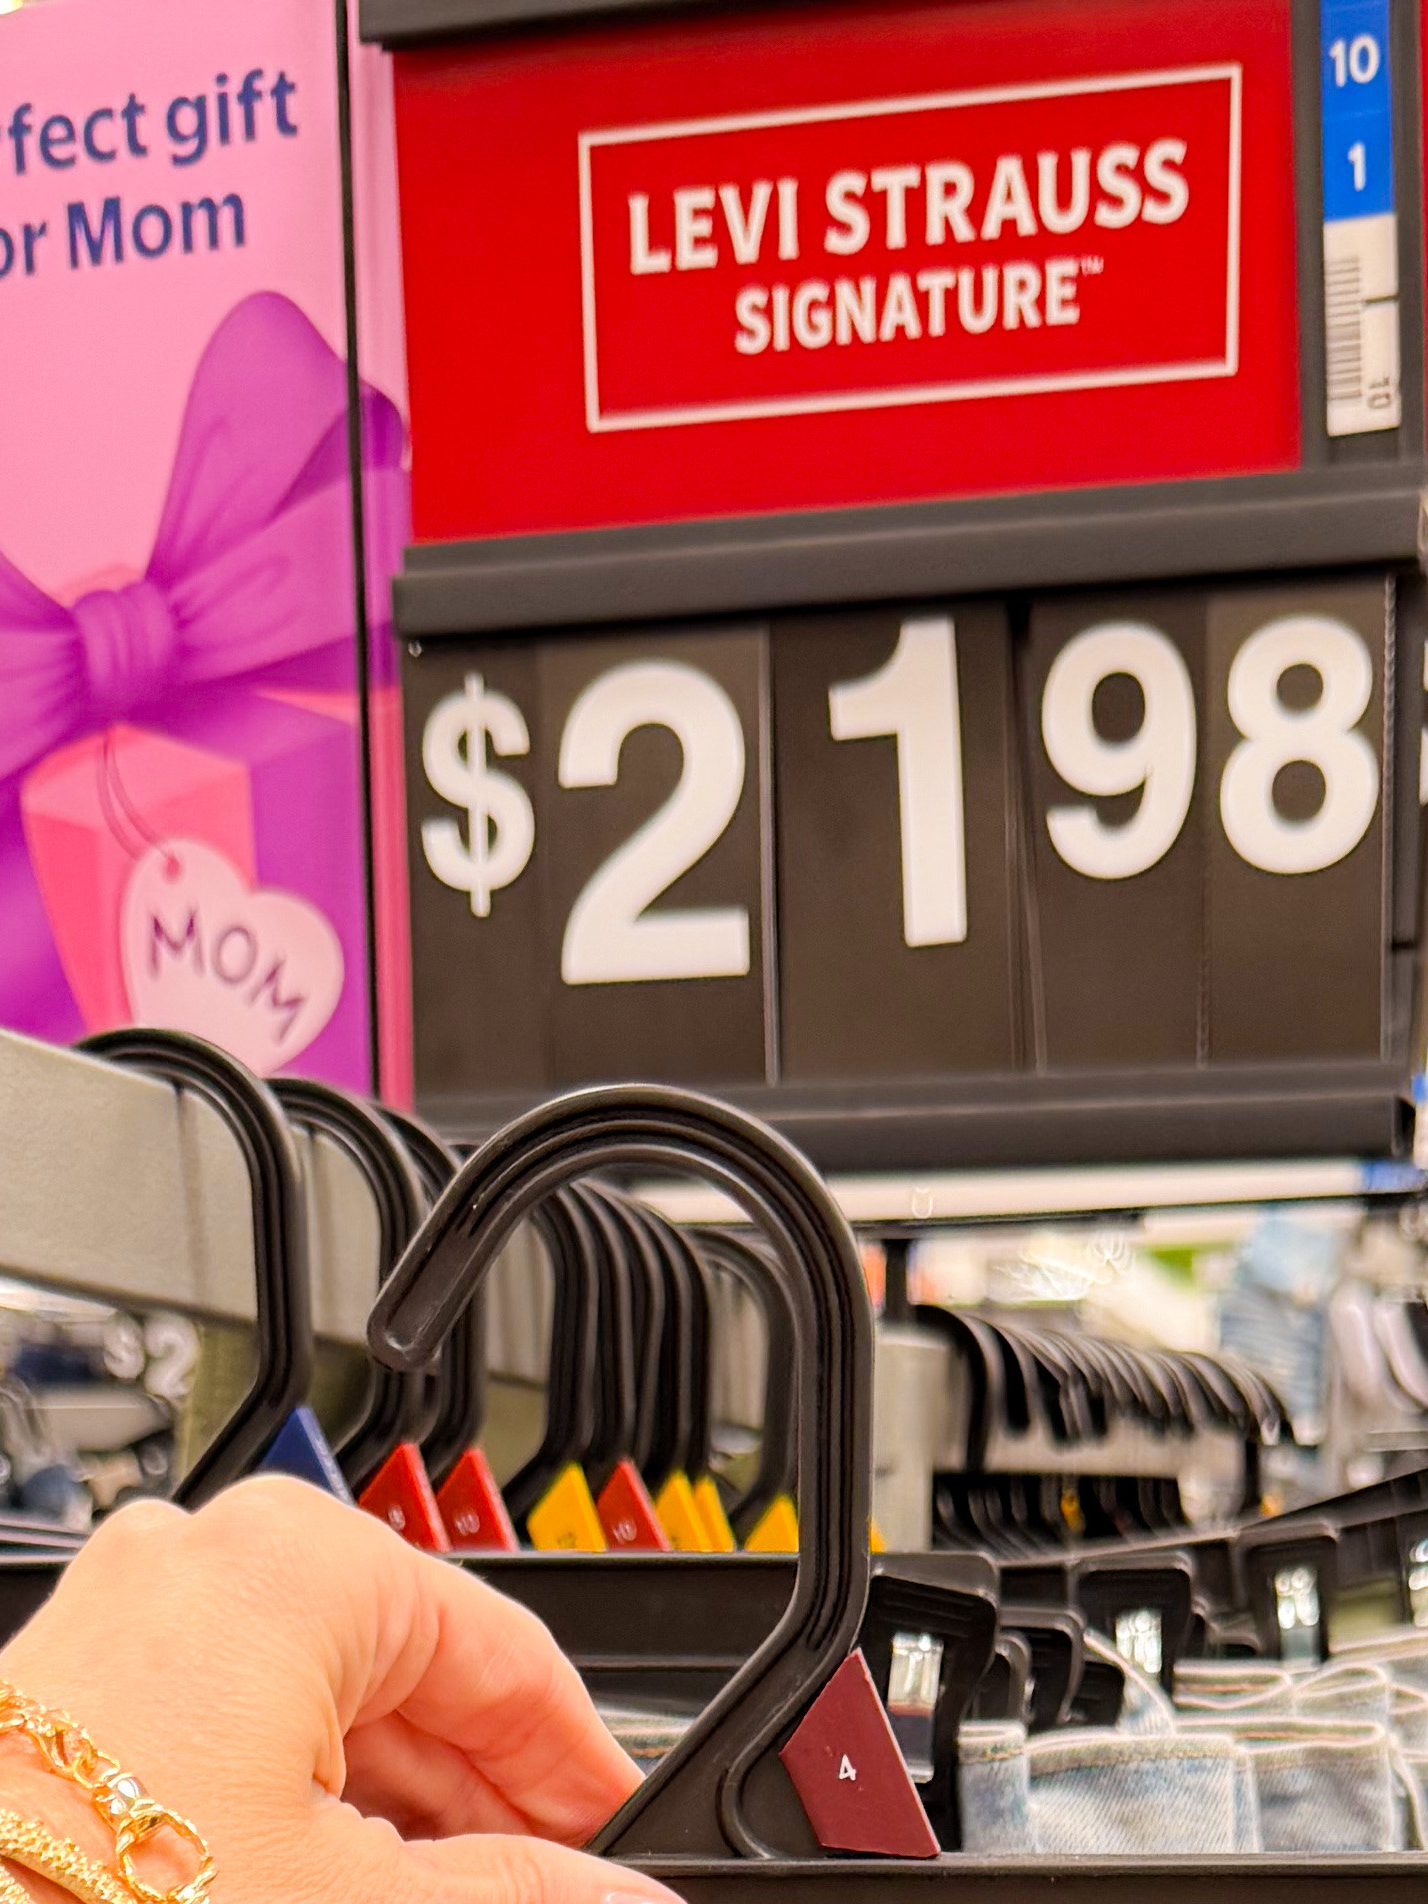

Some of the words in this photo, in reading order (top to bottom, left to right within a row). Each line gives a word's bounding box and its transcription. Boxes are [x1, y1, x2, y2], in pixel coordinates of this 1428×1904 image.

[1329, 34, 1381, 88] 10
[165, 67, 299, 167] gift
[1346, 141, 1367, 192] 1
[66, 192, 247, 271] Mom
[628, 174, 800, 276] LEVI
[823, 137, 1190, 256] STRAUSS
[149, 907, 307, 1045] MOM
[837, 1752, 857, 1782] 4
